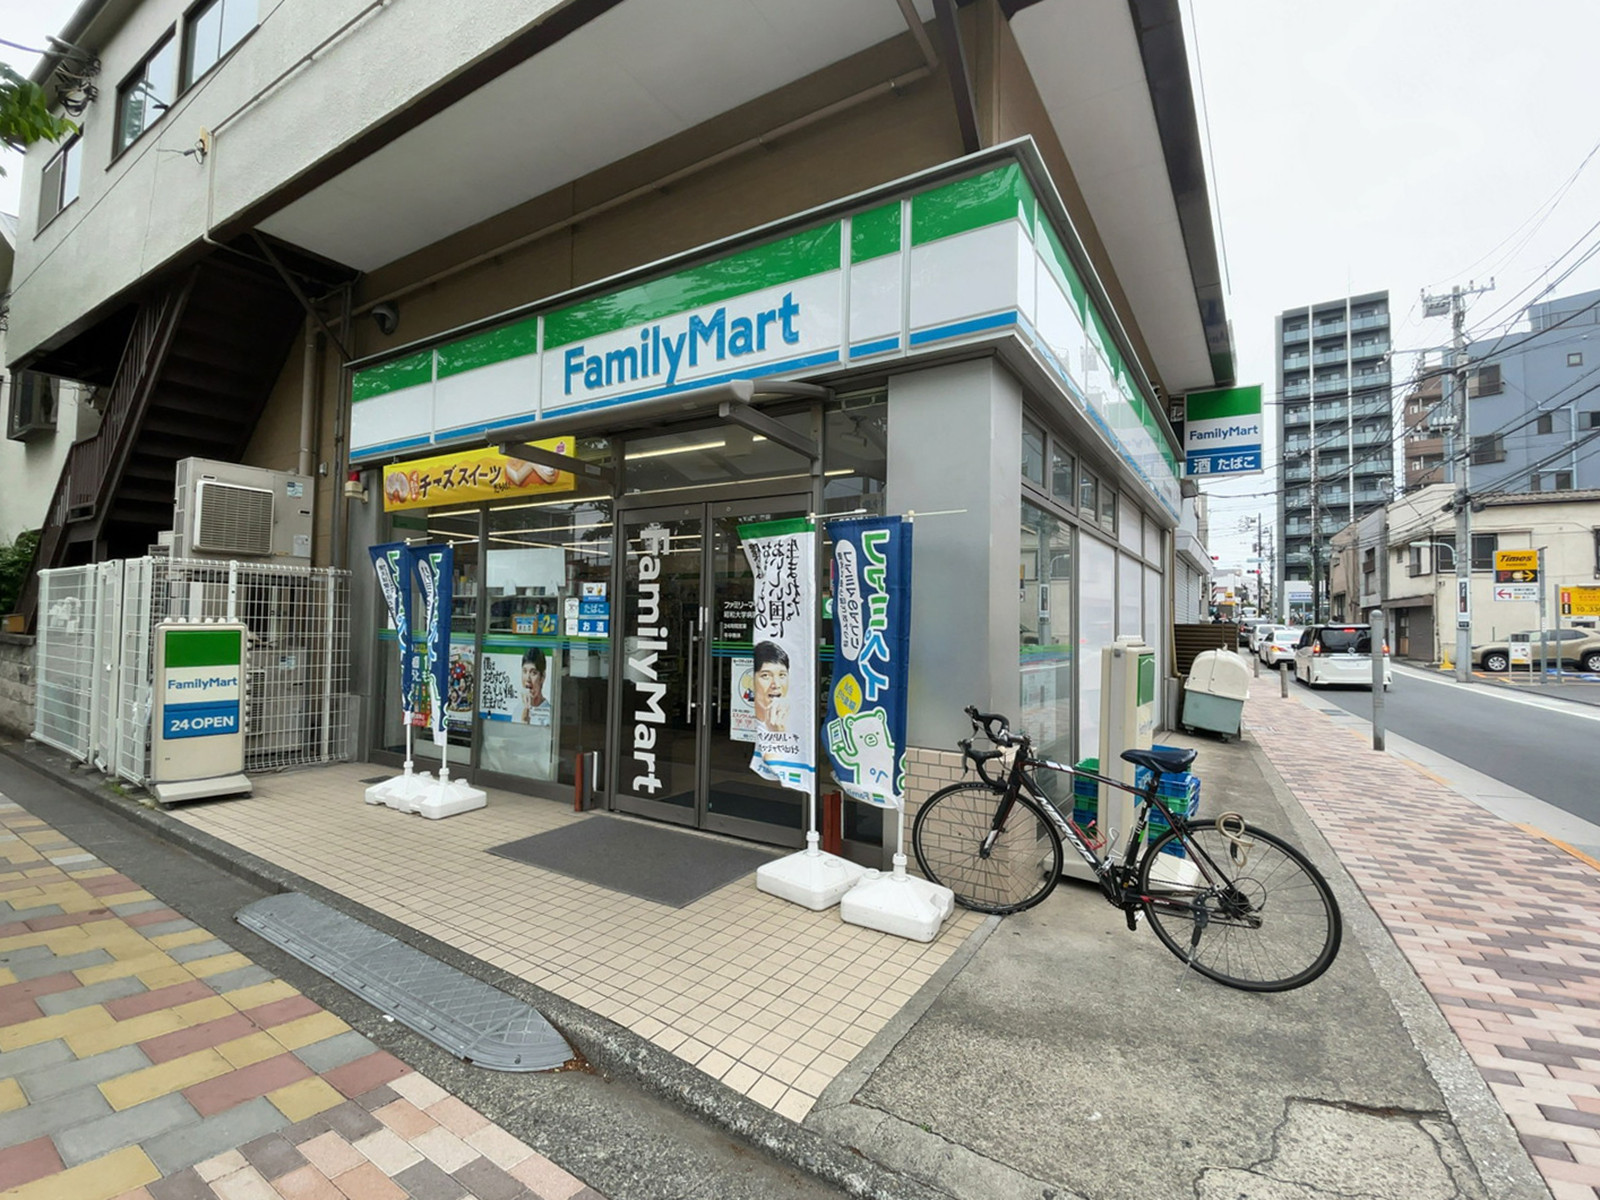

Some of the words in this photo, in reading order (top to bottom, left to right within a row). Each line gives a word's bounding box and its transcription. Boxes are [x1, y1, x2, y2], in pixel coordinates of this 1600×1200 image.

[564, 291, 800, 395] FamilyMart
[1189, 425, 1258, 440] FamilyMart
[1193, 457, 1211, 473] 酒
[1217, 456, 1255, 470] たばこ
[1500, 554, 1533, 563] Times
[583, 604, 605, 614] たばこ
[724, 600, 755, 610] ファミリーマ
[628, 528, 670, 794] FamilyMart
[167, 677, 238, 691] FamilyMart
[170, 718, 190, 732] 24
[191, 715, 234, 729] OPEN
